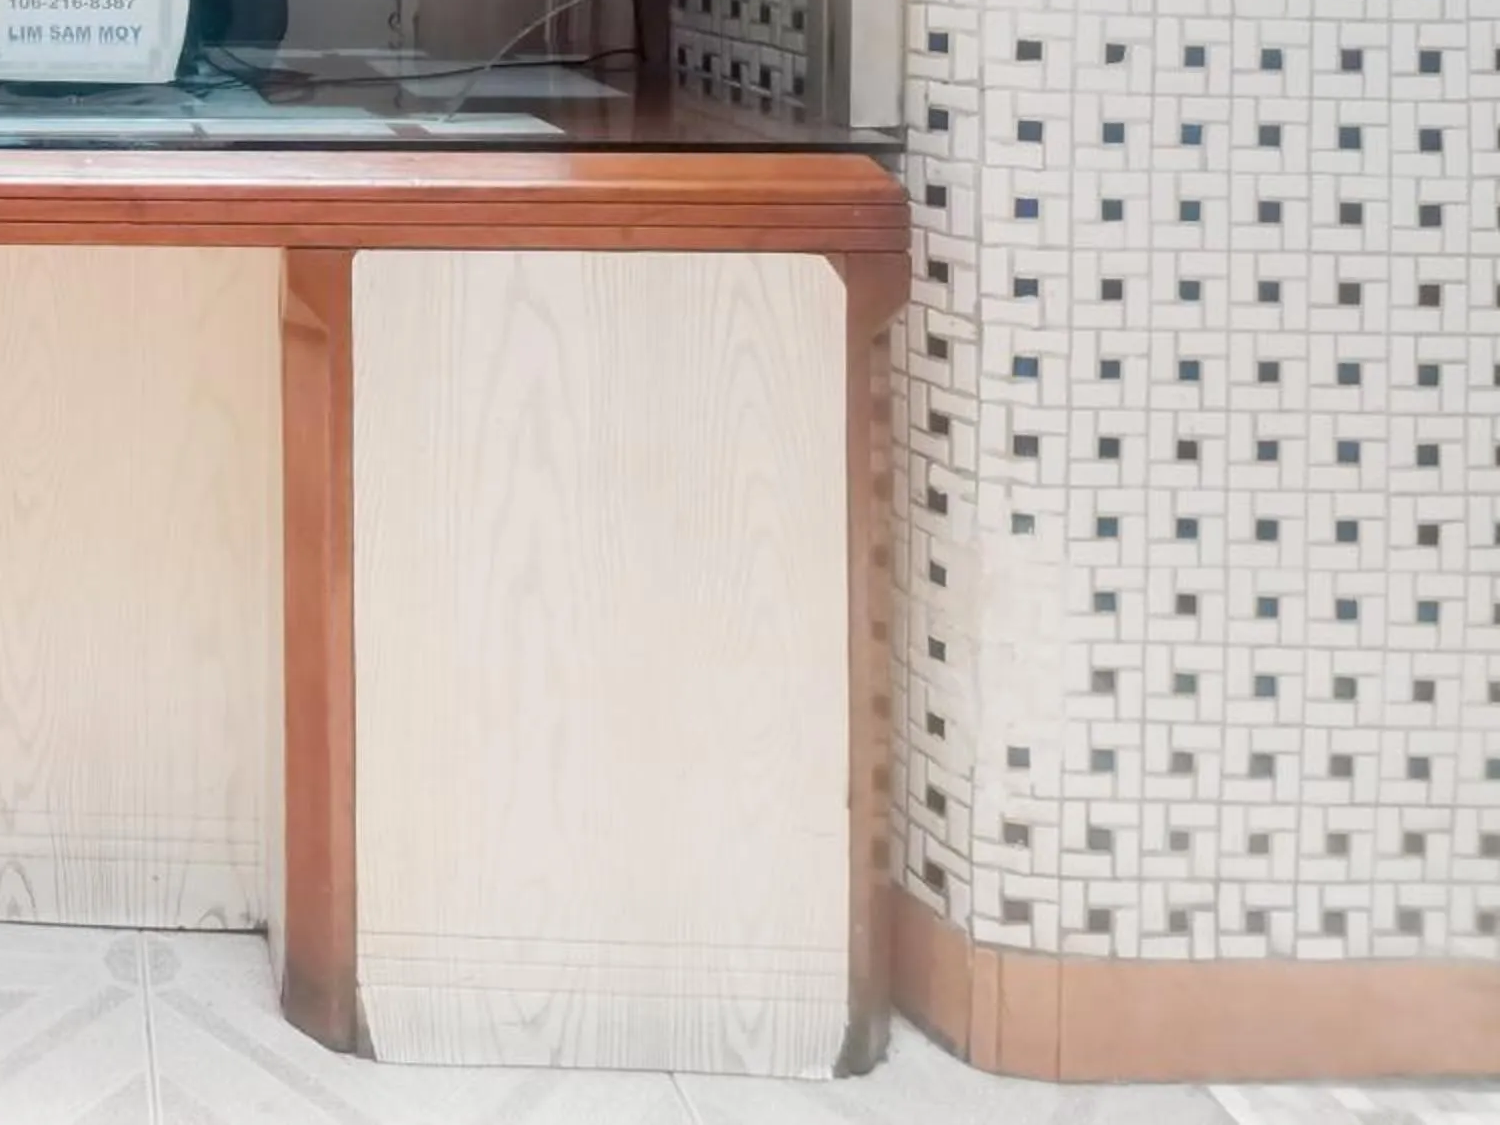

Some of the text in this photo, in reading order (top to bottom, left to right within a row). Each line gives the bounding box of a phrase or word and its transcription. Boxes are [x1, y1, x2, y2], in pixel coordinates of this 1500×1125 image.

[8, 26, 143, 43] LIM SAM MOY
